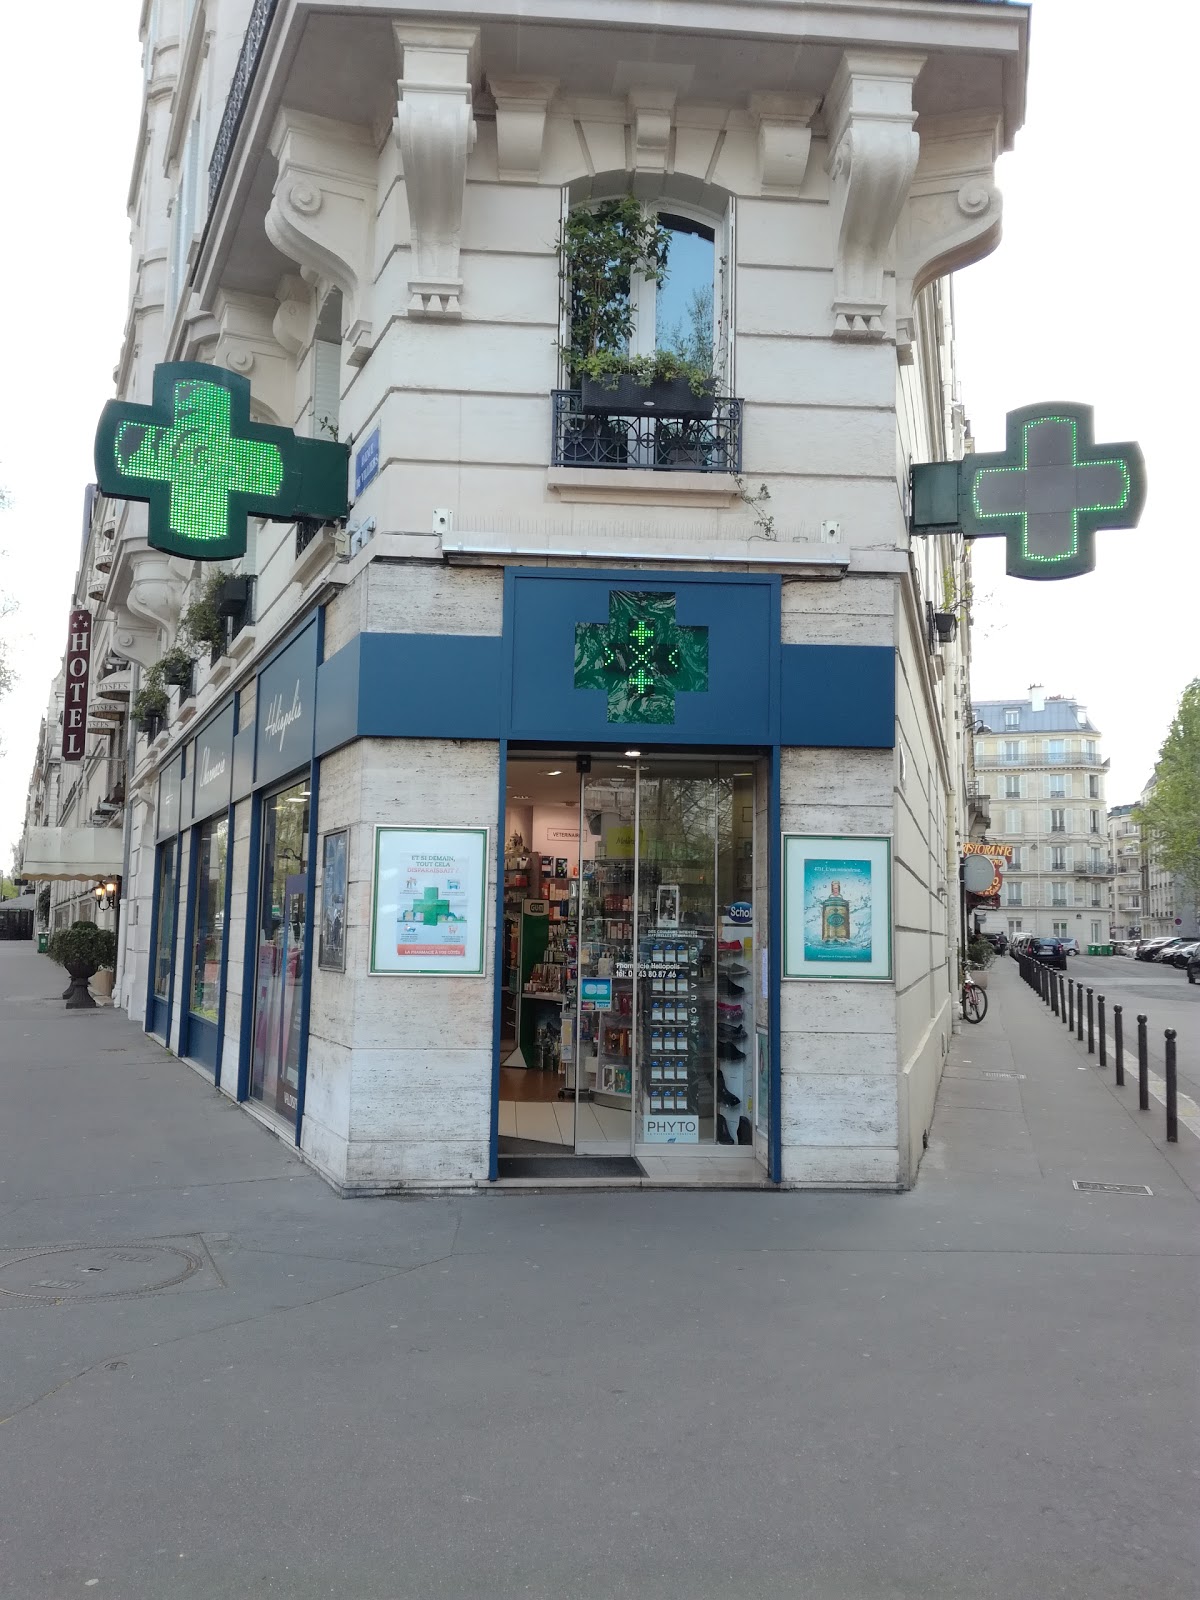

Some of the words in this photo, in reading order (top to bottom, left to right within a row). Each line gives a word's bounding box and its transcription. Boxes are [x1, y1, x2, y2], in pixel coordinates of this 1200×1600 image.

[66, 631, 90, 754] HOTEL
[552, 831, 580, 839] VETERINAIR
[730, 906, 752, 918] Schol
[616, 962, 650, 970] Pharmcie
[651, 962, 680, 970] Heliopolis
[647, 1121, 696, 1132] PHYTO
